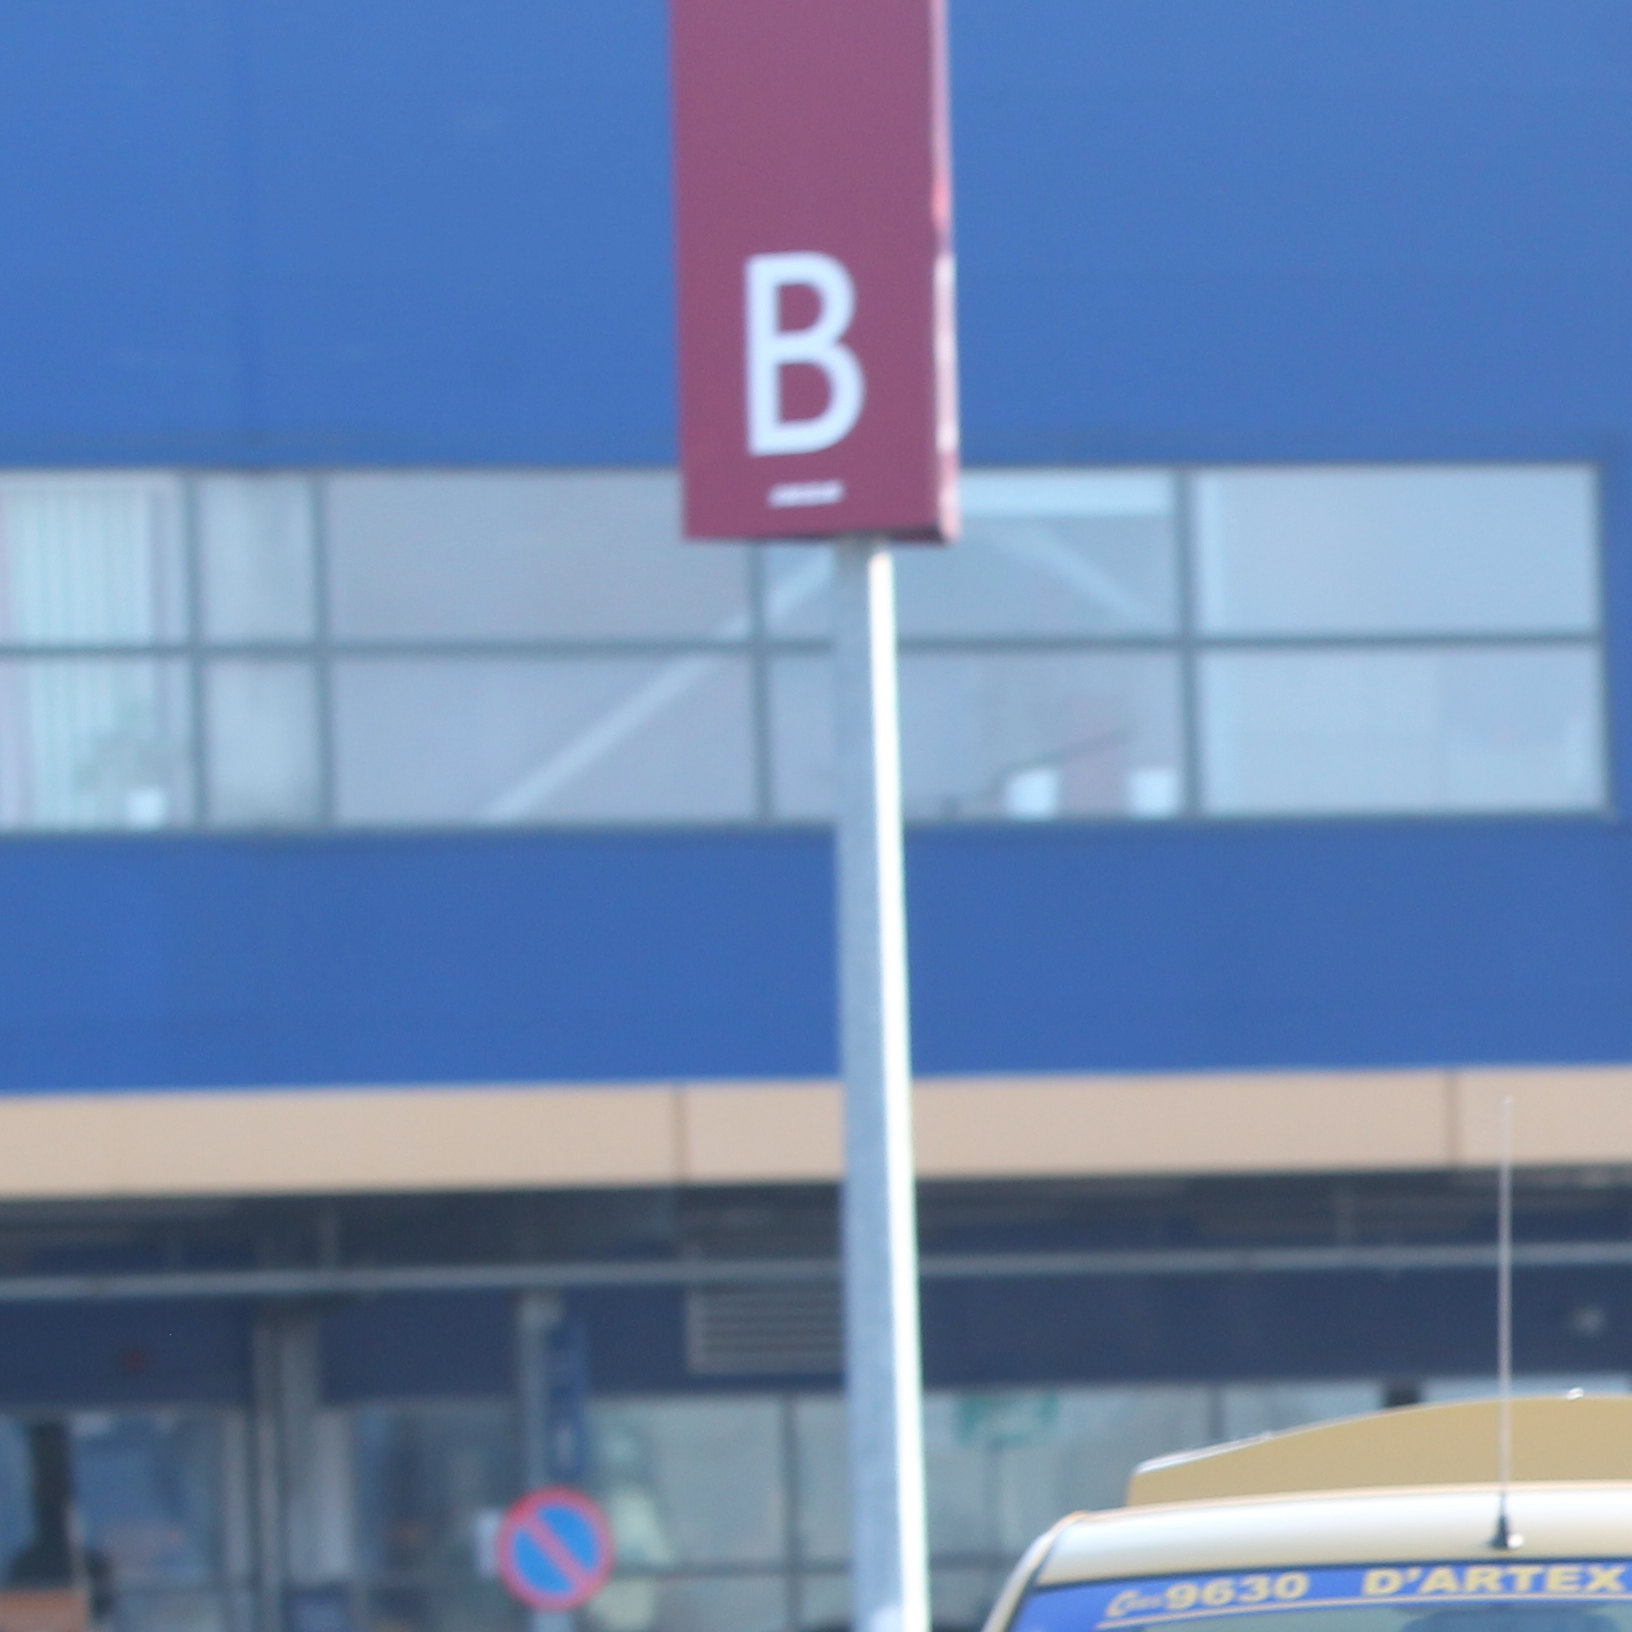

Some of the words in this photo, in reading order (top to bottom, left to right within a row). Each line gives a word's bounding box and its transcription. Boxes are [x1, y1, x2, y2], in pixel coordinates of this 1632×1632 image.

[744, 250, 864, 456] B
[1165, 1573, 1310, 1610] 9630
[1362, 1566, 1626, 1597] D'ARTEX
